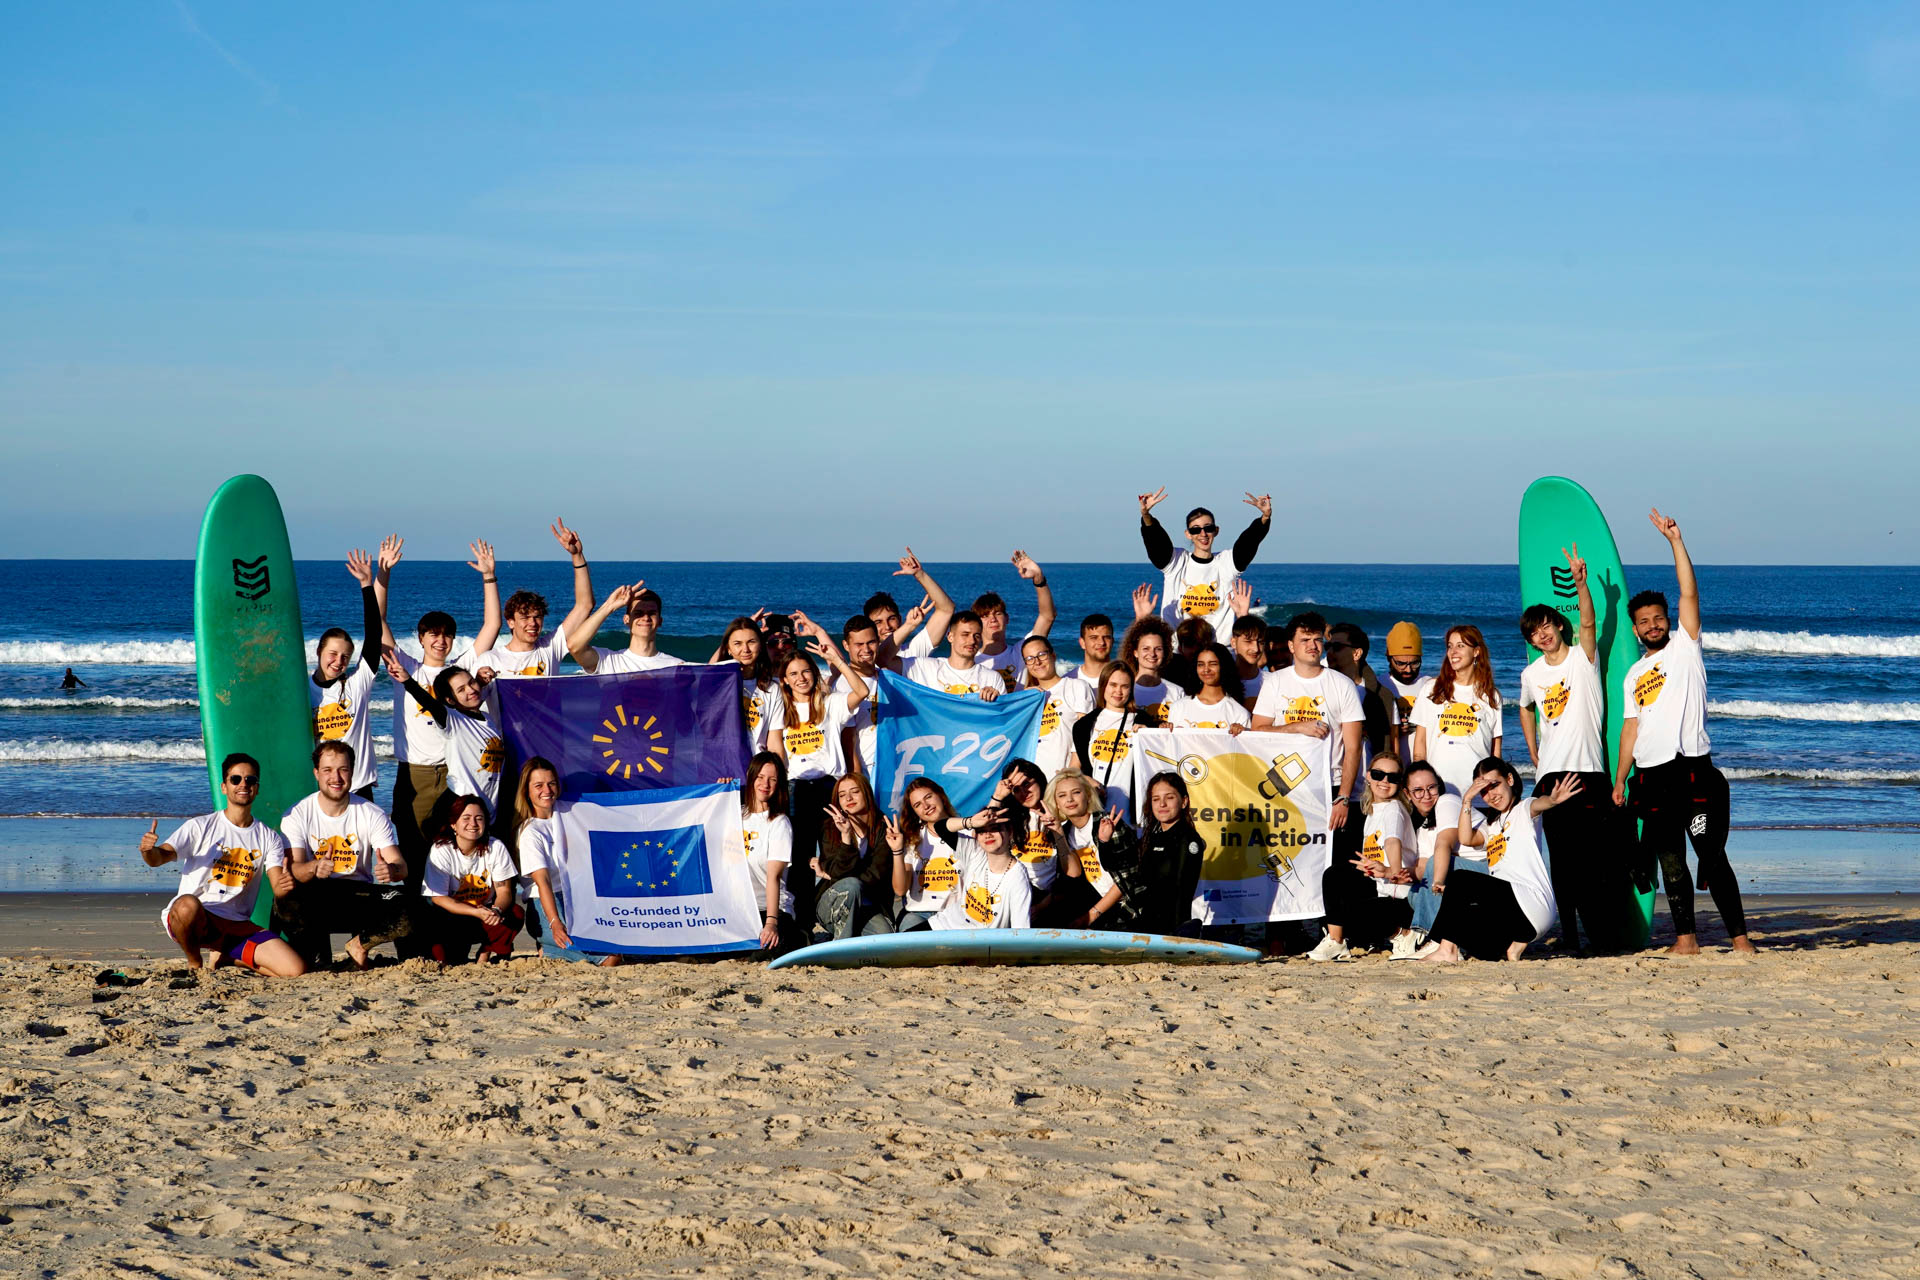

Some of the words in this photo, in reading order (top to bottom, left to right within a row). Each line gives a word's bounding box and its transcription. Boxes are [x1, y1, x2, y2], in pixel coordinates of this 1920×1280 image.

[1555, 603, 1580, 613] FLOW
[1643, 681, 1663, 695] ACTION
[331, 713, 356, 721] PEOPLE
[1458, 715, 1482, 723] PEOPLE
[325, 721, 349, 730] ACTION
[797, 736, 820, 744] ACTION
[1189, 803, 1289, 828] zenship
[1221, 826, 1242, 847] in
[1247, 827, 1326, 847] Action
[235, 861, 259, 873] PEOPLE
[227, 868, 251, 878] ACTION
[611, 906, 681, 916] Co-funded
[683, 905, 700, 917] by
[594, 917, 616, 927] the
[618, 919, 684, 931] European
[686, 916, 727, 928] Union
